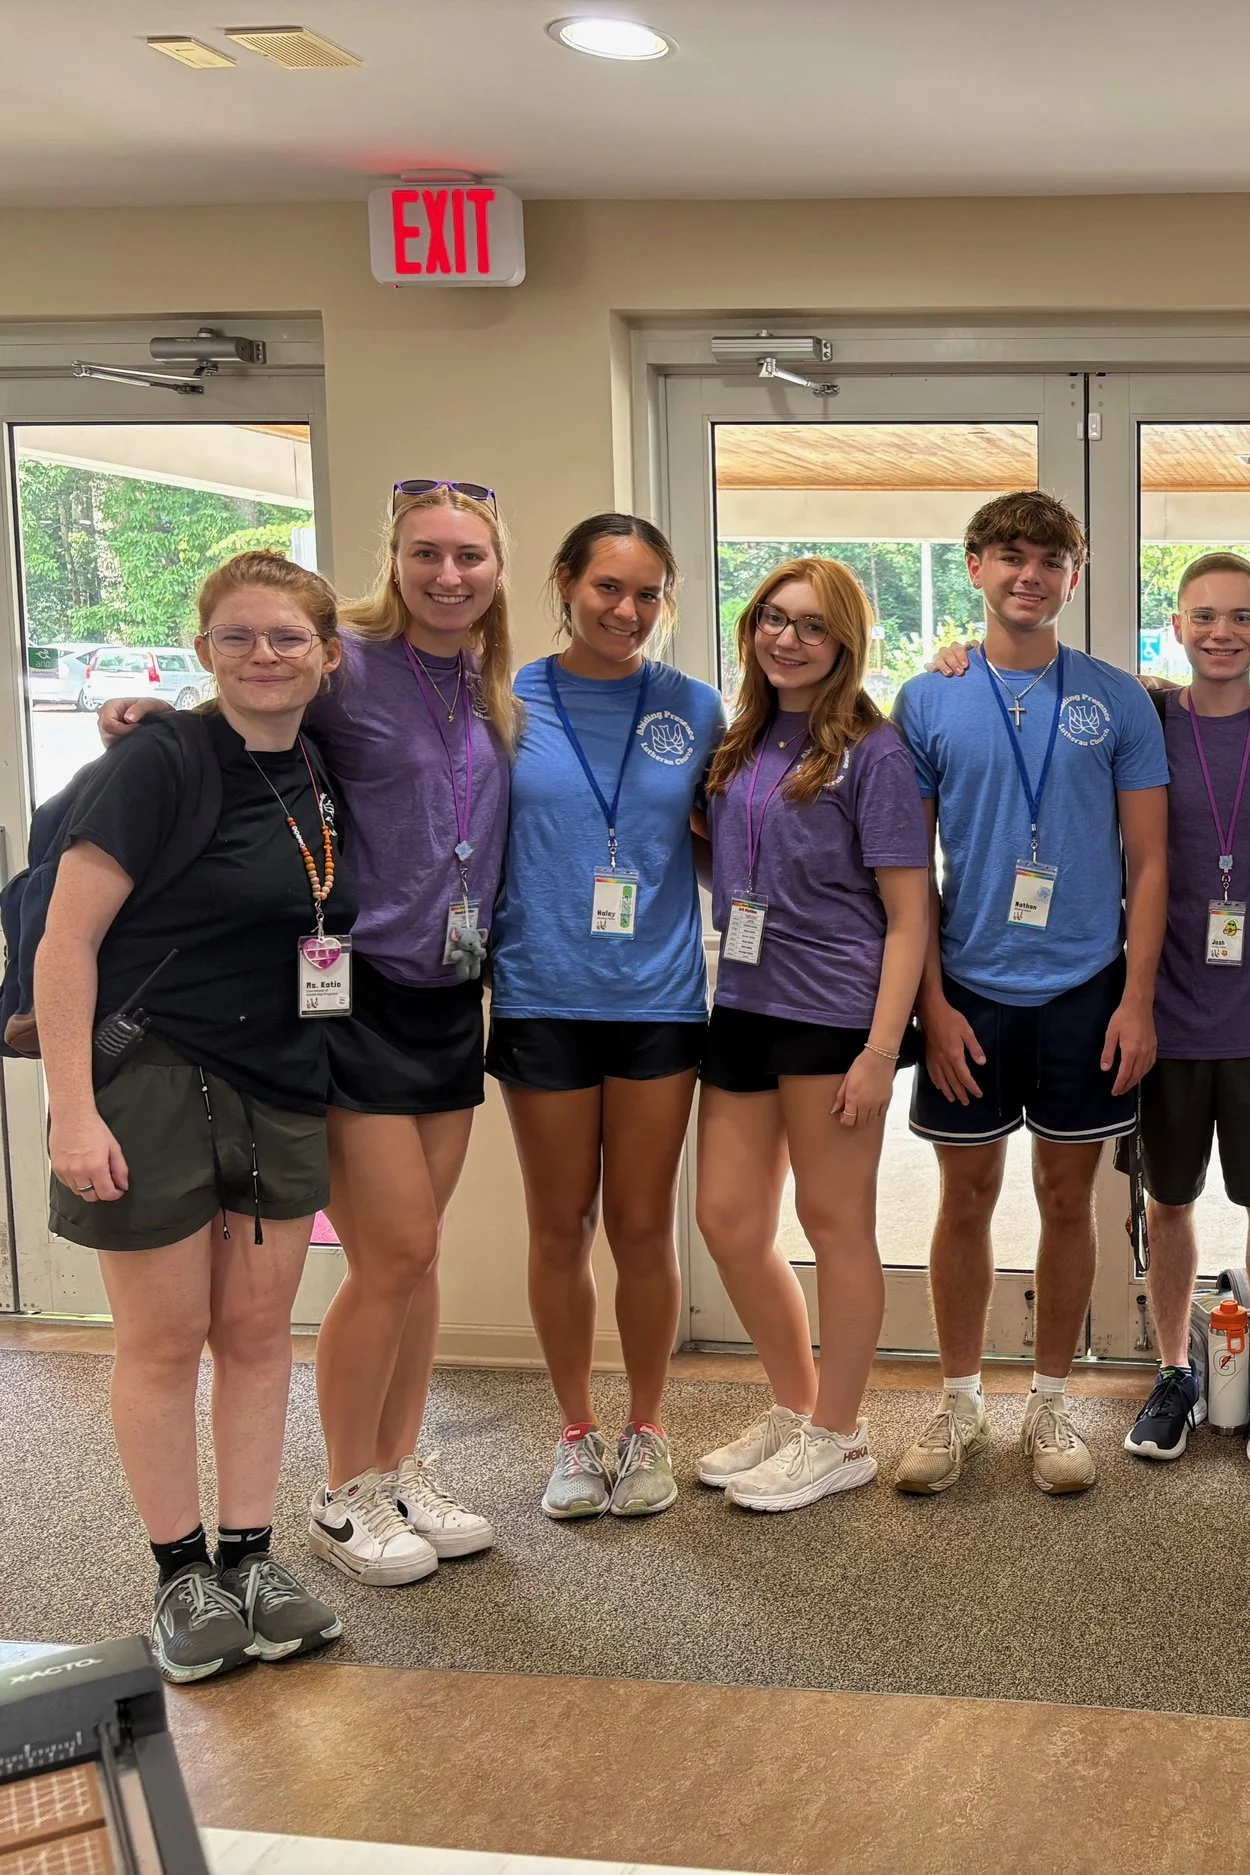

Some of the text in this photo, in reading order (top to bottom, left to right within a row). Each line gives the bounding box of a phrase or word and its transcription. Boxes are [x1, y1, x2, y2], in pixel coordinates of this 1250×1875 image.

[392, 189, 495, 274] EXIT
[1082, 694, 1110, 722] Presence
[636, 711, 695, 740] Abiding Presence
[1058, 723, 1110, 746] Lutheran Church
[641, 742, 694, 765] Lutheran Church
[597, 910, 616, 918] Haley
[1014, 901, 1037, 910] Nathan
[842, 1445, 868, 1463] HOKA
